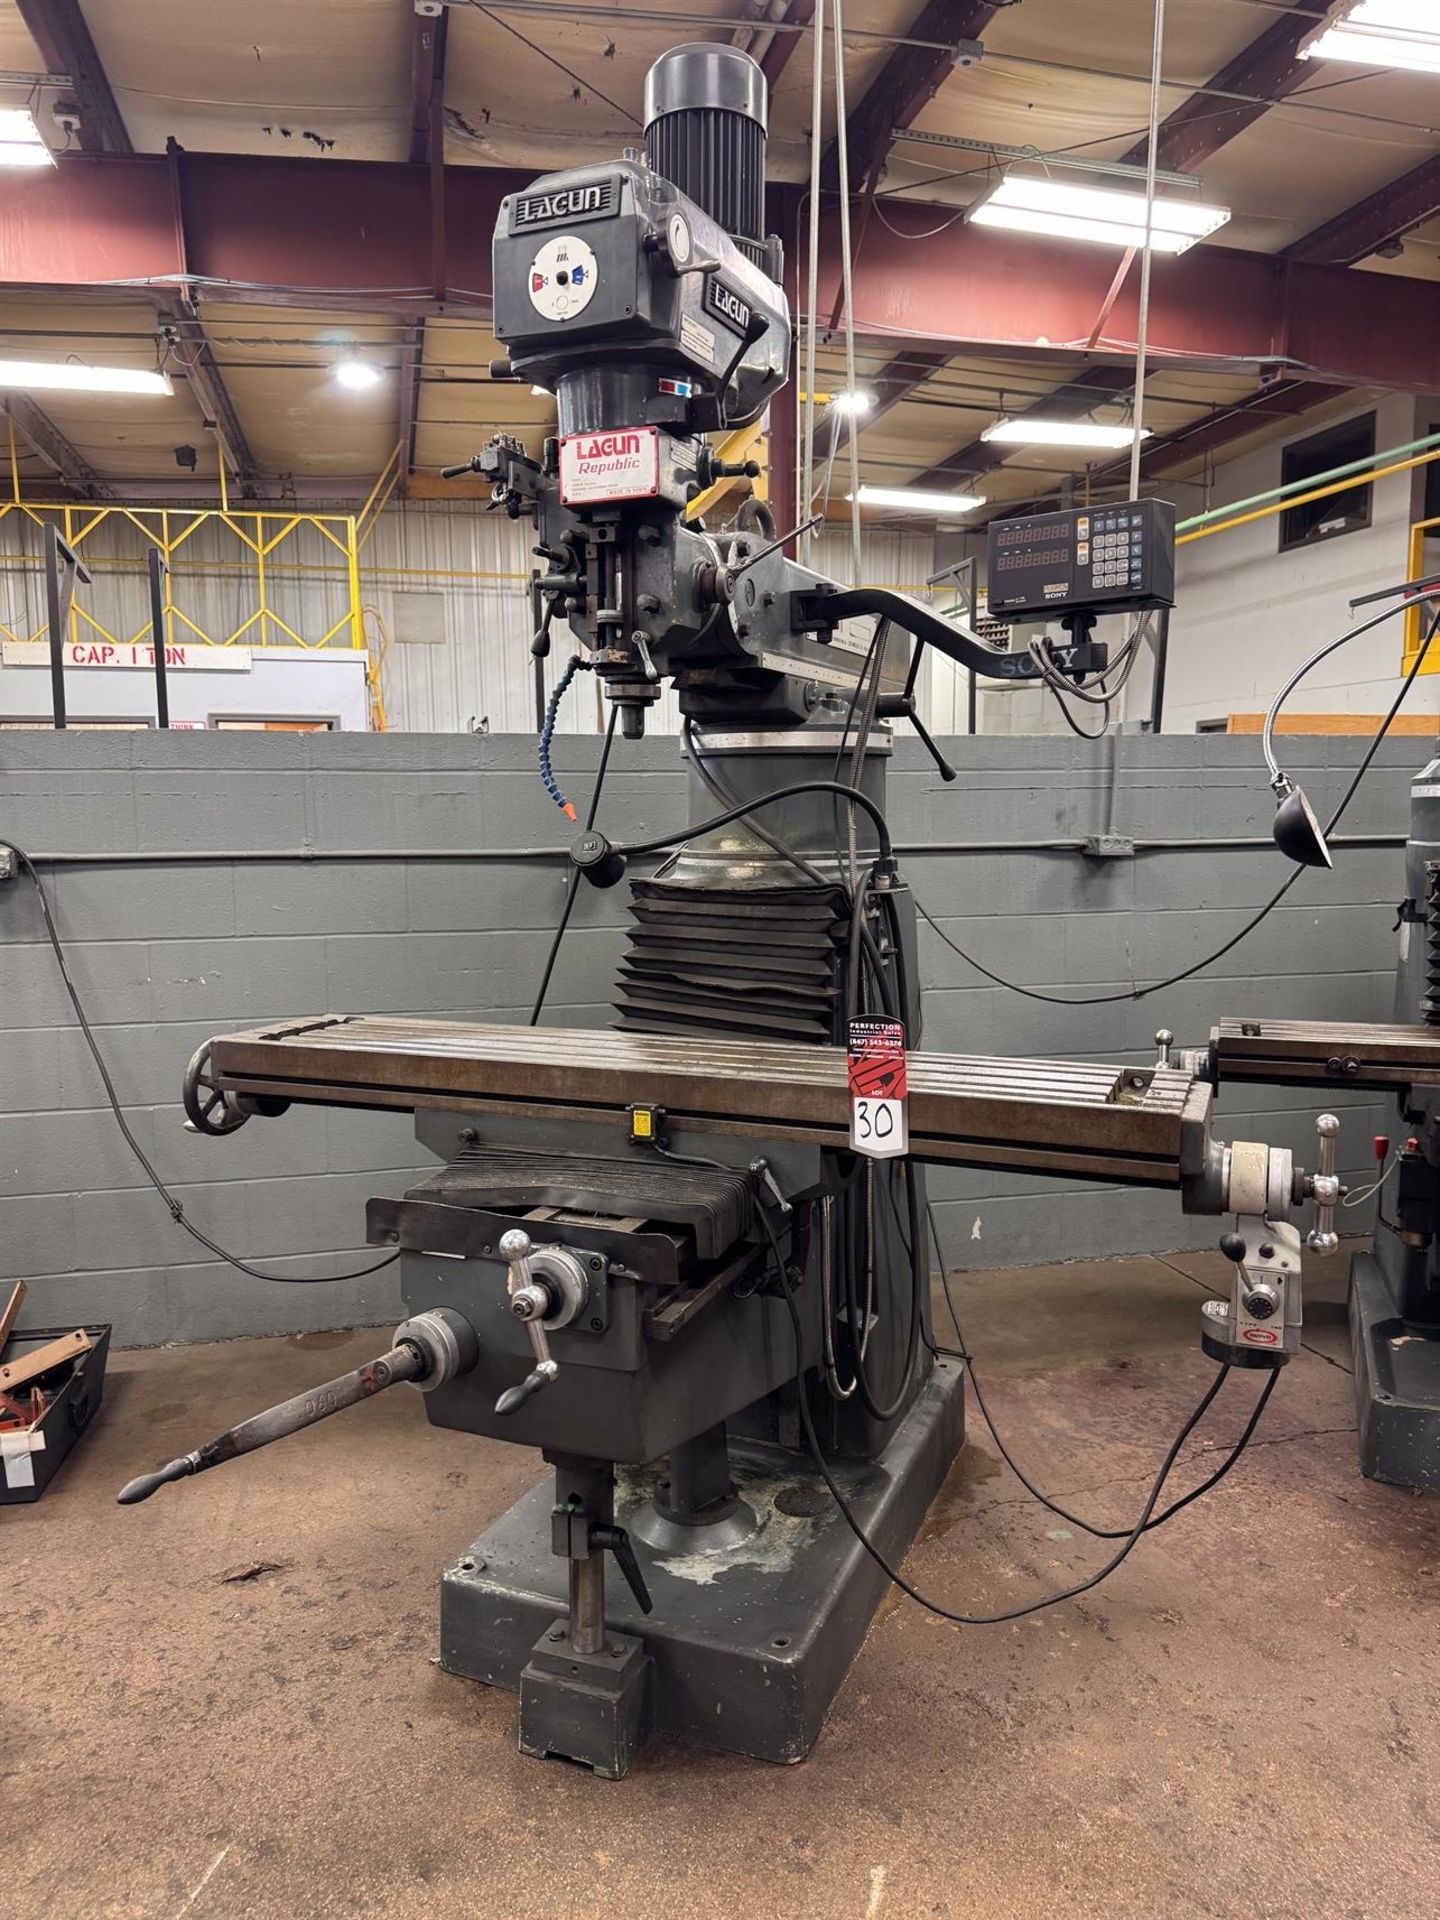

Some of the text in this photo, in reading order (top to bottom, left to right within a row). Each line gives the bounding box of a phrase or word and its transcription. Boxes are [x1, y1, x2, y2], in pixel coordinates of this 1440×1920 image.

[523, 186, 601, 222] LAGUN
[715, 283, 750, 329] LAGUN
[576, 435, 640, 460] LAGUN
[578, 457, 641, 475] Republic
[1045, 591, 1067, 599] SONY
[72, 645, 120, 664] CAP.
[1000, 647, 1079, 676] SOY
[849, 1022, 901, 1031] PERFECTION
[858, 1101, 893, 1139] 30
